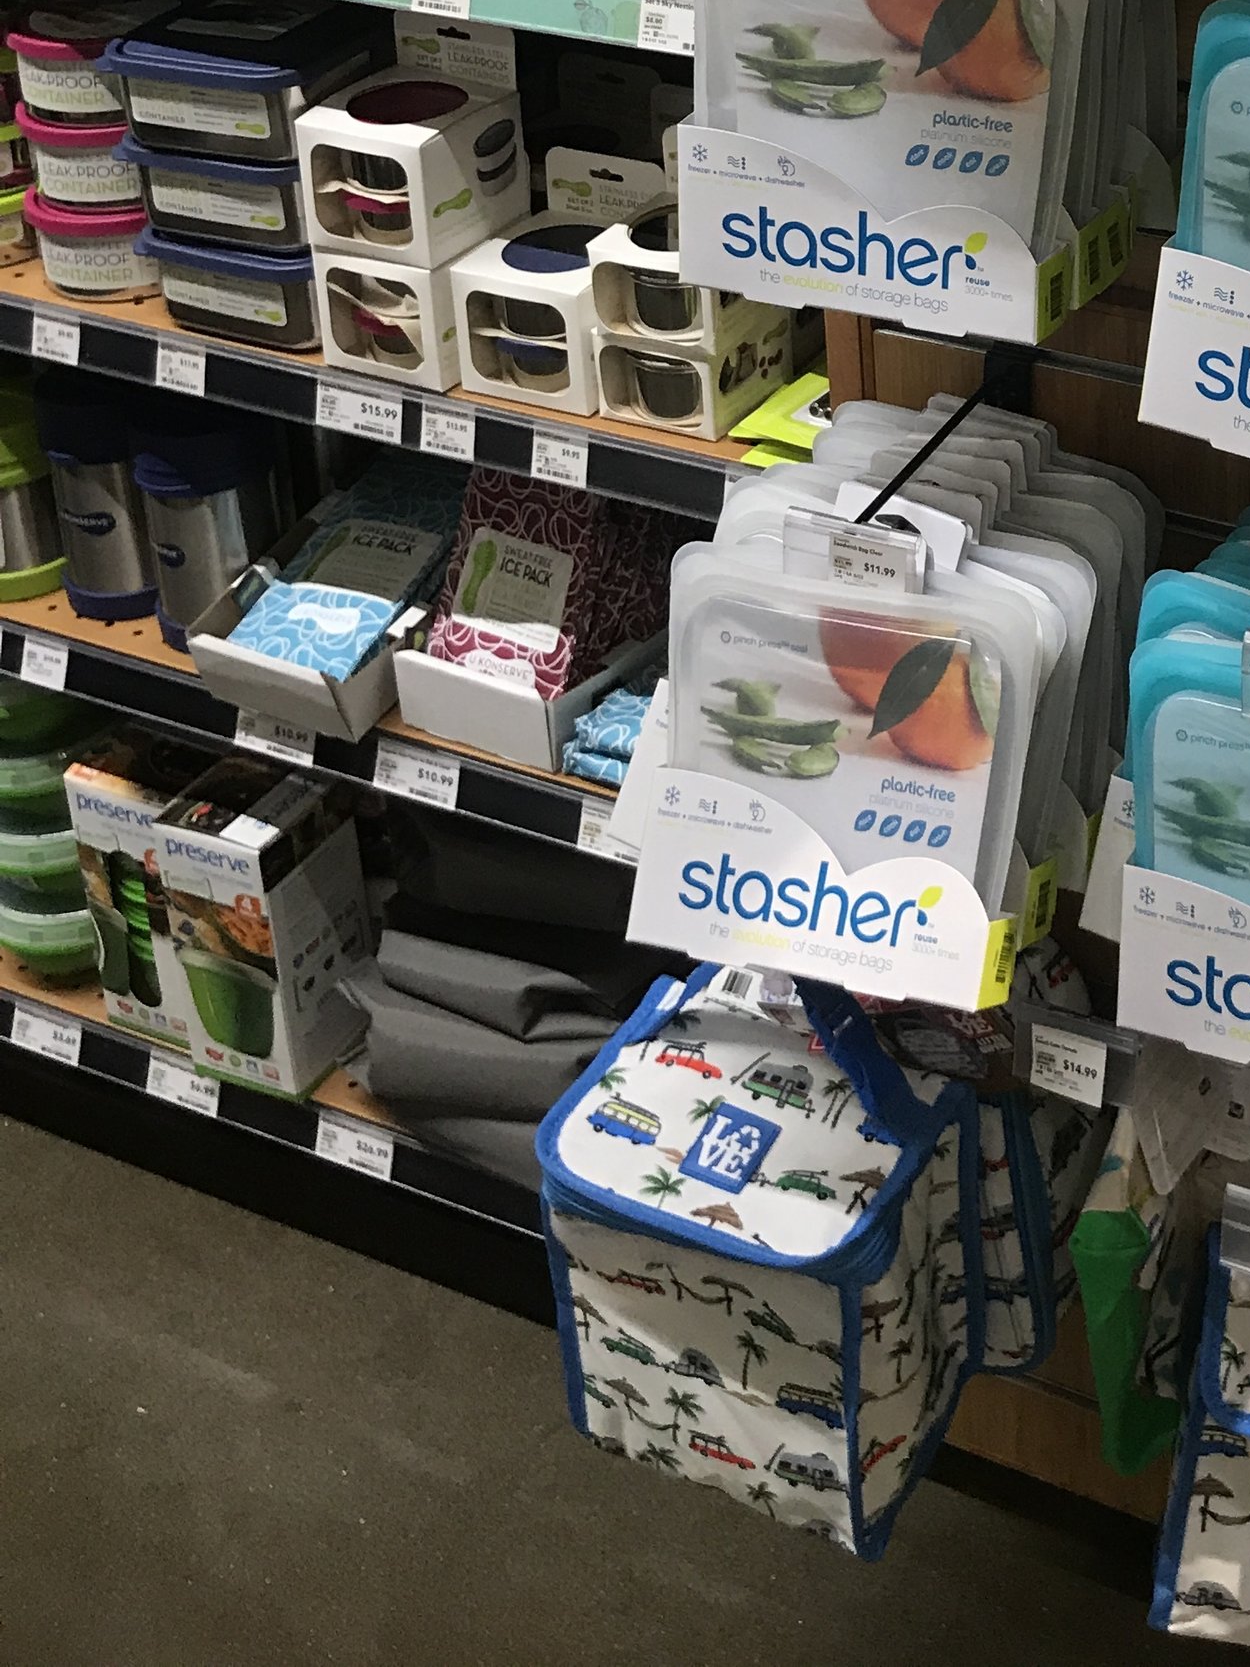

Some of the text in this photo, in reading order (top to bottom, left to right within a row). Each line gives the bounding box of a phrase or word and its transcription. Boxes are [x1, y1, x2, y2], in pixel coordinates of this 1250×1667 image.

[931, 109, 1014, 133] plastic-free
[721, 205, 964, 291] stasher
[759, 267, 949, 314] the evolution of storage bags
[965, 275, 991, 287] reuse
[1167, 289, 1196, 307] freezer
[1202, 300, 1245, 319] microwave
[360, 401, 398, 421] $15.99
[352, 533, 417, 558] ICE PACK
[500, 556, 555, 589] ICE PACK
[863, 561, 897, 580] $11.99
[418, 767, 454, 787] $10.99
[880, 775, 956, 803] plastic-free
[75, 791, 156, 830] preserve
[165, 836, 250, 875] preserve
[678, 852, 918, 948] stasher
[709, 920, 731, 940] the
[792, 936, 808, 953] of
[807, 940, 857, 965] storage
[858, 948, 894, 973] bags
[1203, 1018, 1227, 1037] the
[1062, 1059, 1098, 1080] $14.99
